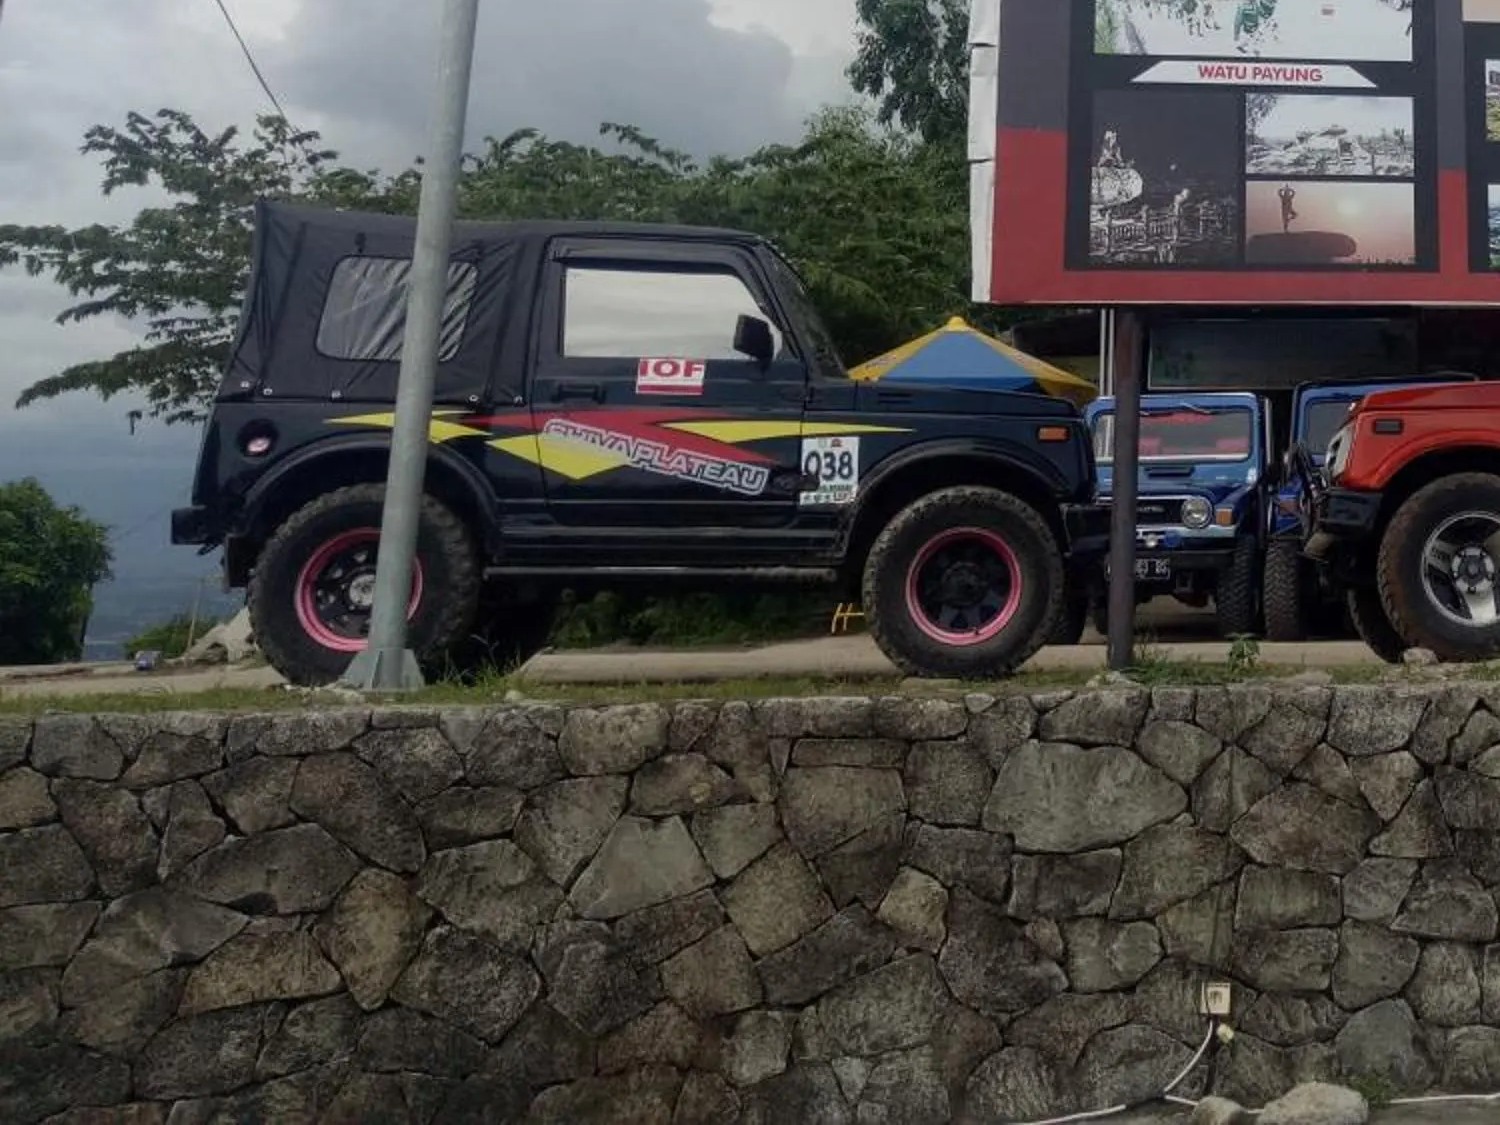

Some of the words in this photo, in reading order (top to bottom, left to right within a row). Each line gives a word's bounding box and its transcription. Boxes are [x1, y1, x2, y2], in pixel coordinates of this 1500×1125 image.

[1198, 64, 1247, 80] WATU
[1252, 66, 1324, 82] PAYUNG
[638, 359, 705, 378] IOF
[804, 450, 854, 482] 038
